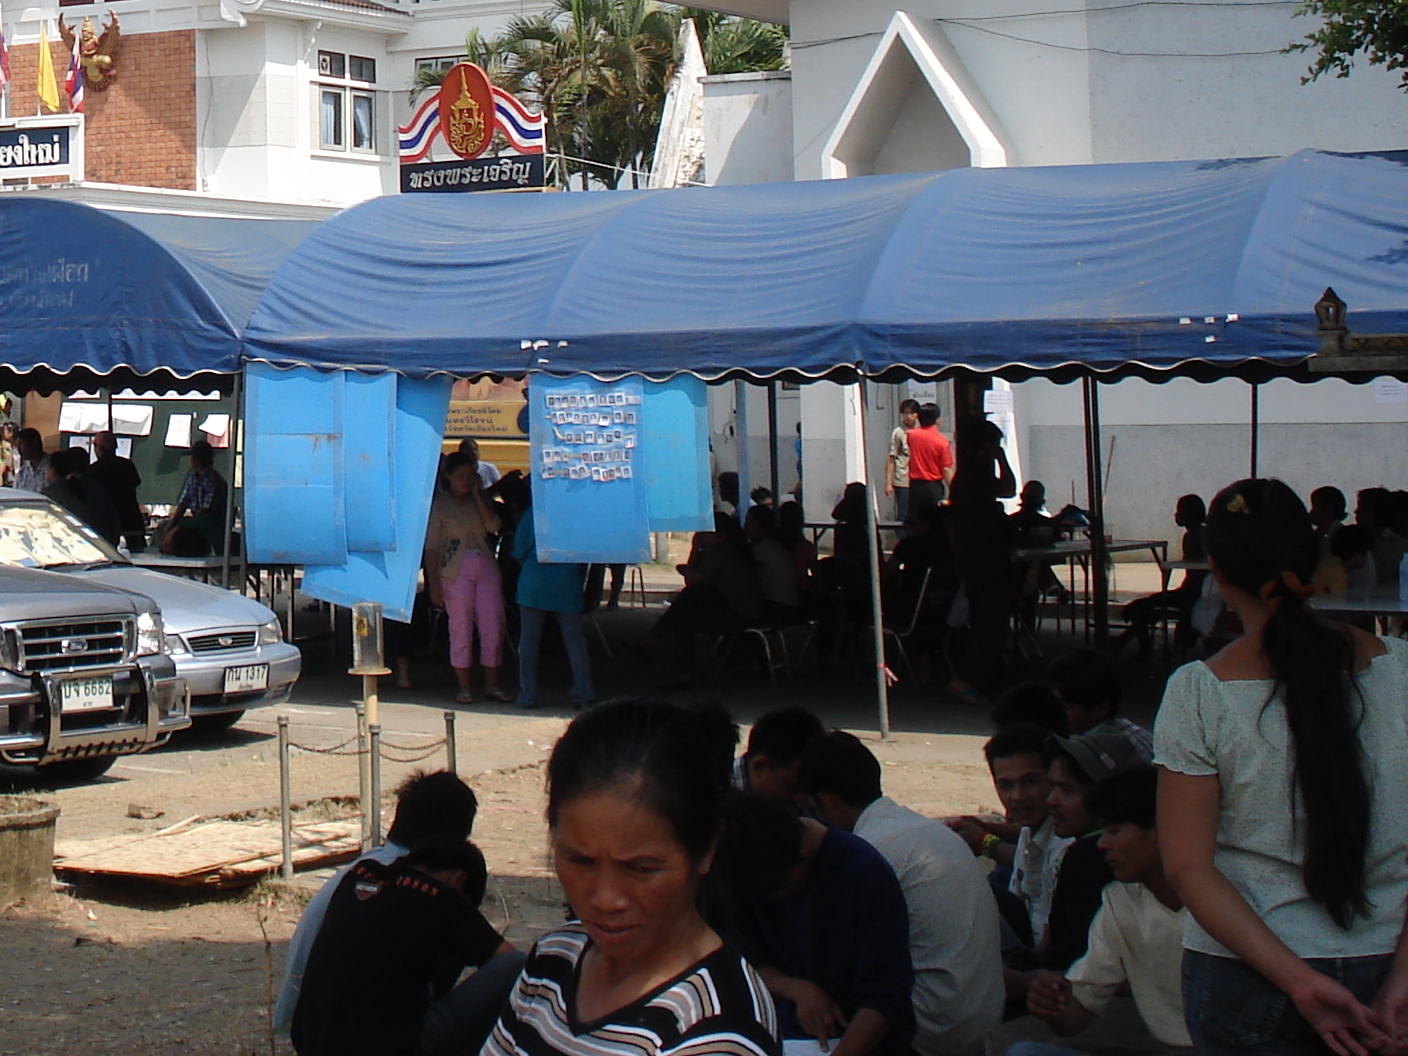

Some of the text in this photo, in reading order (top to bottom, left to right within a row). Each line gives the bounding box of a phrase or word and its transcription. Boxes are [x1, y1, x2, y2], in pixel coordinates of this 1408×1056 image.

[409, 158, 531, 188] ทรงพระเจริญ
[245, 665, 266, 681] 1317
[84, 679, 111, 697] 6682
